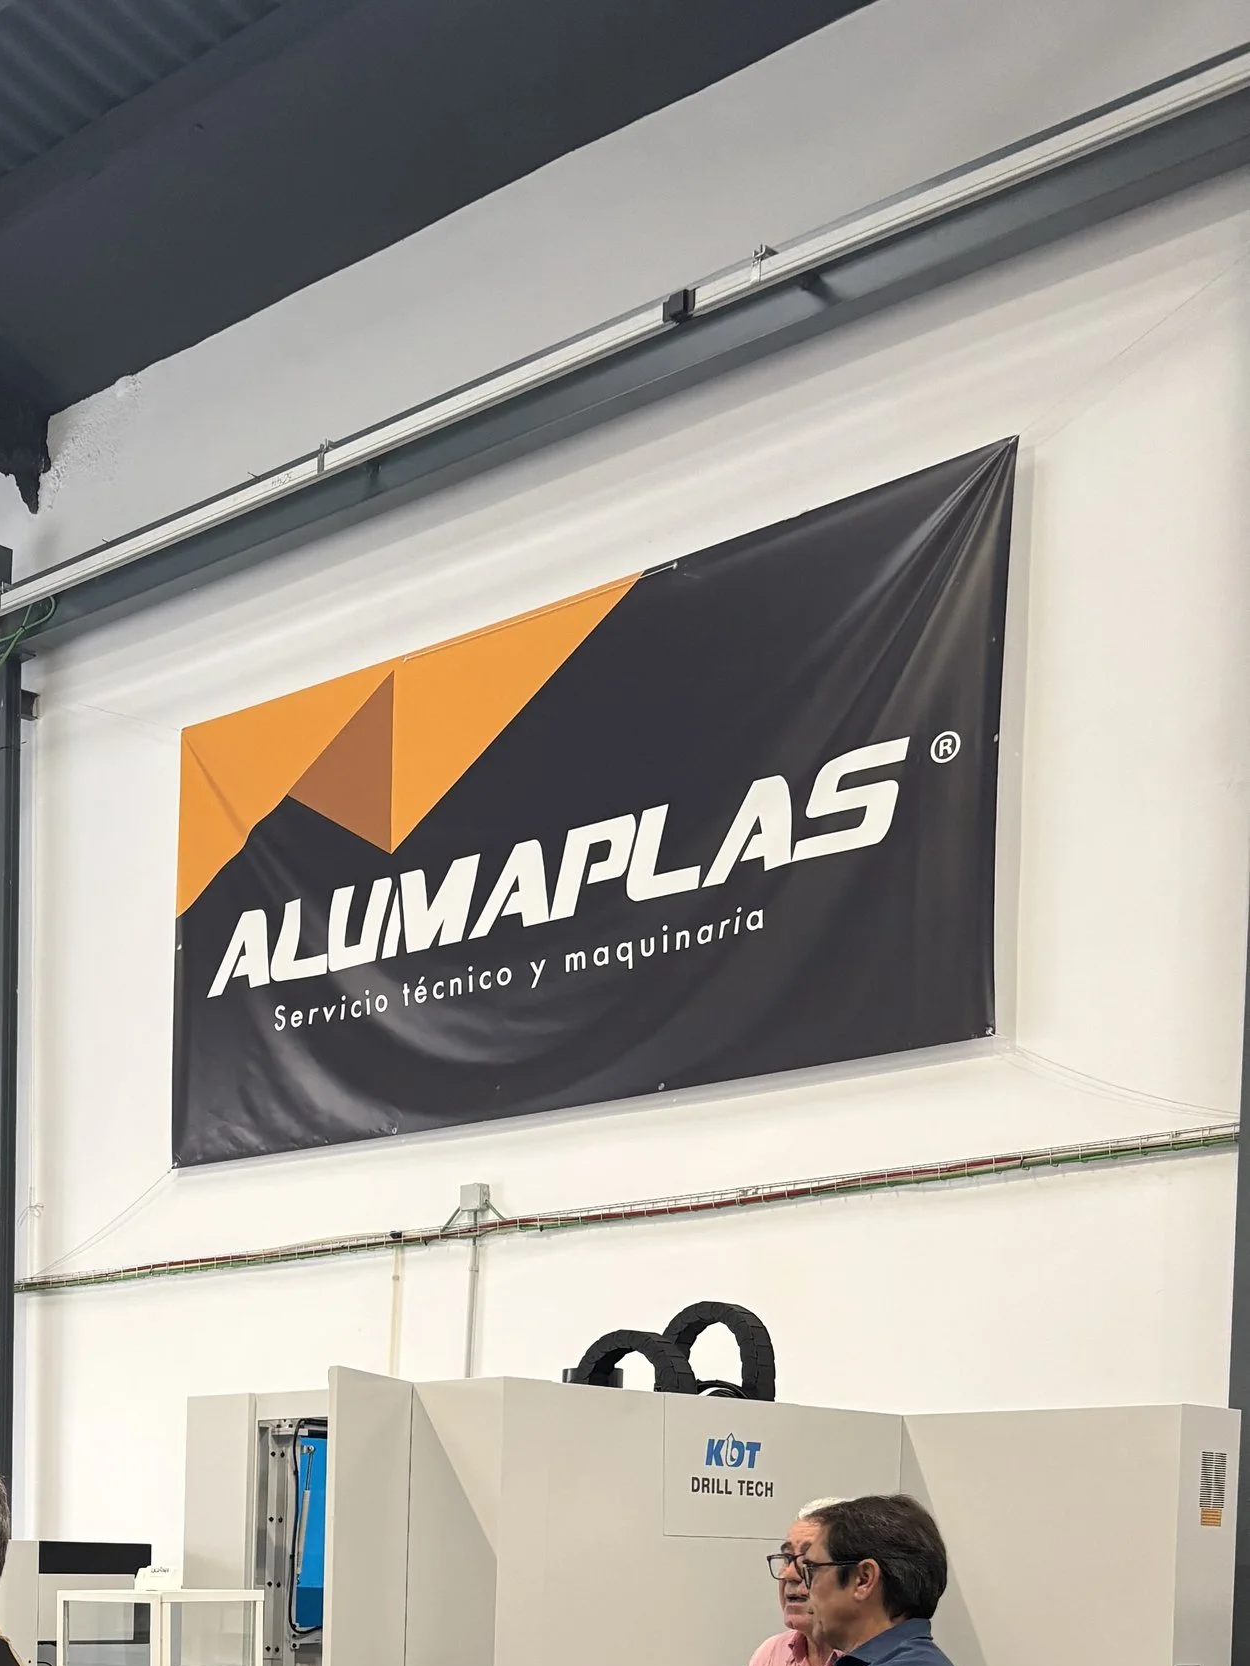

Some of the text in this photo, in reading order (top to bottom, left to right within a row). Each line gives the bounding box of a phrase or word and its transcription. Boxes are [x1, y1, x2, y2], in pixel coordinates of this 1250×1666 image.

[206, 736, 911, 999] ALUMAPLAS
[274, 906, 764, 1032] Servicio técnico y maquinaria
[691, 1476, 773, 1498] DRILL TECH
[705, 1432, 762, 1469] KDT
